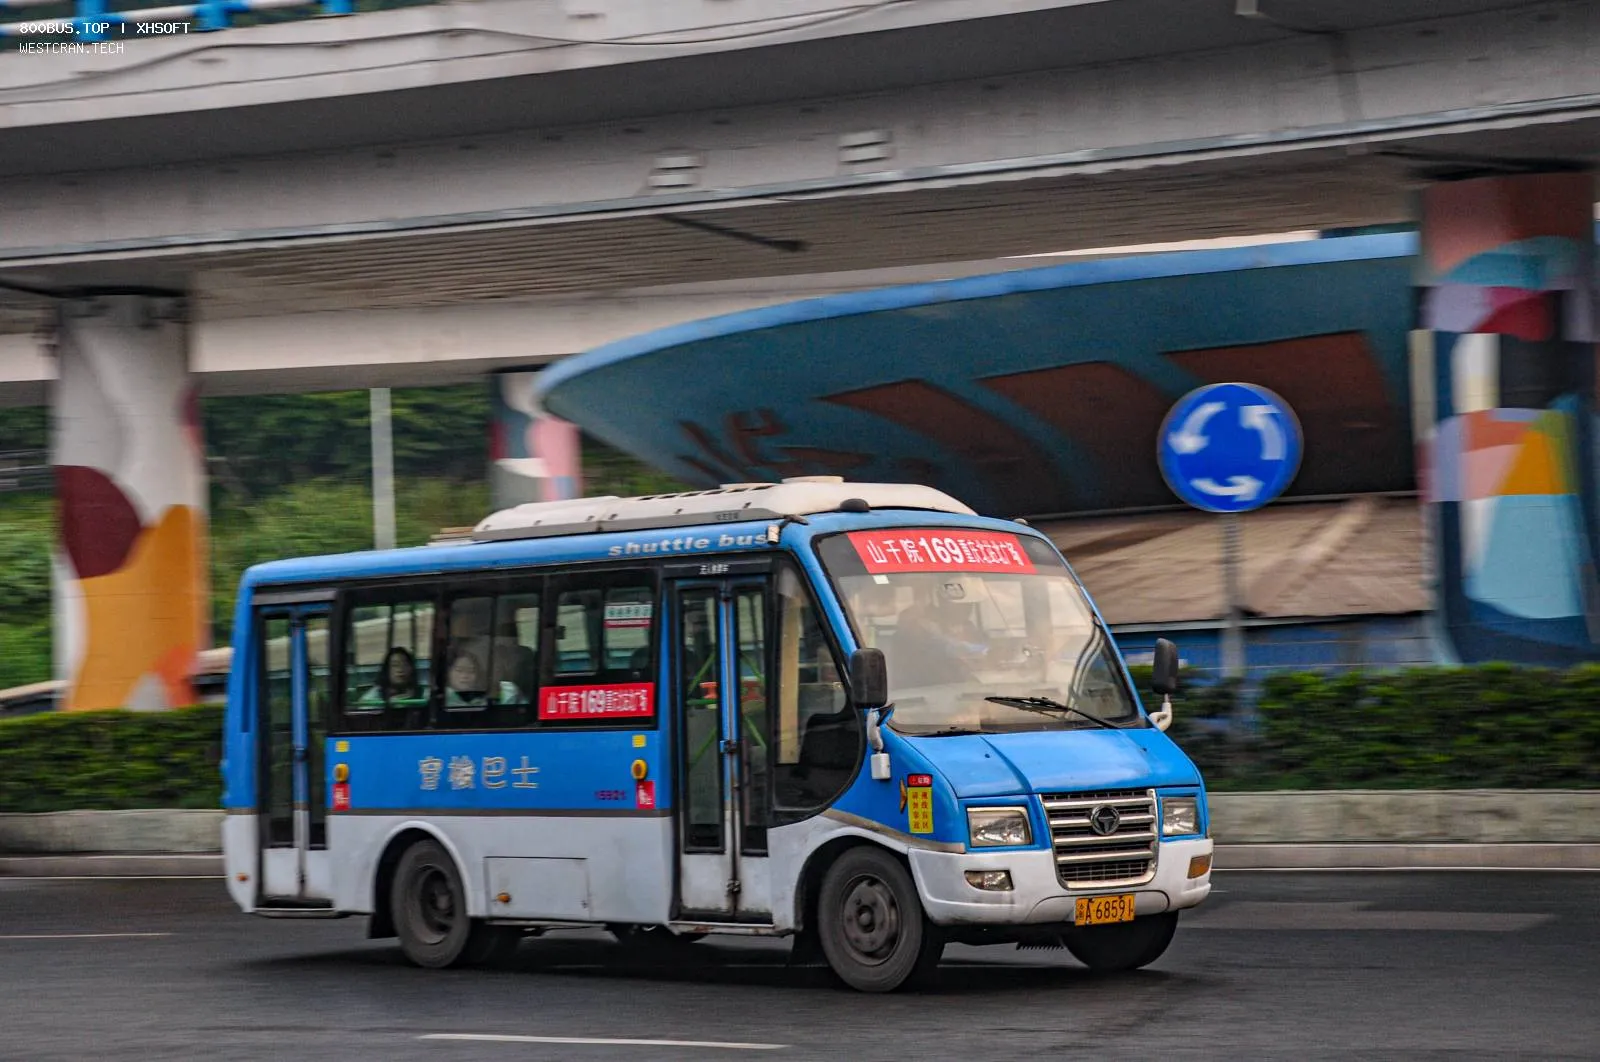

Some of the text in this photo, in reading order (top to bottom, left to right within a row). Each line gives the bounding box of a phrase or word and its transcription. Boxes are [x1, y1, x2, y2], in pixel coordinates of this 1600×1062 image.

[608, 534, 768, 556] shuttle bus
[918, 536, 965, 565] 169
